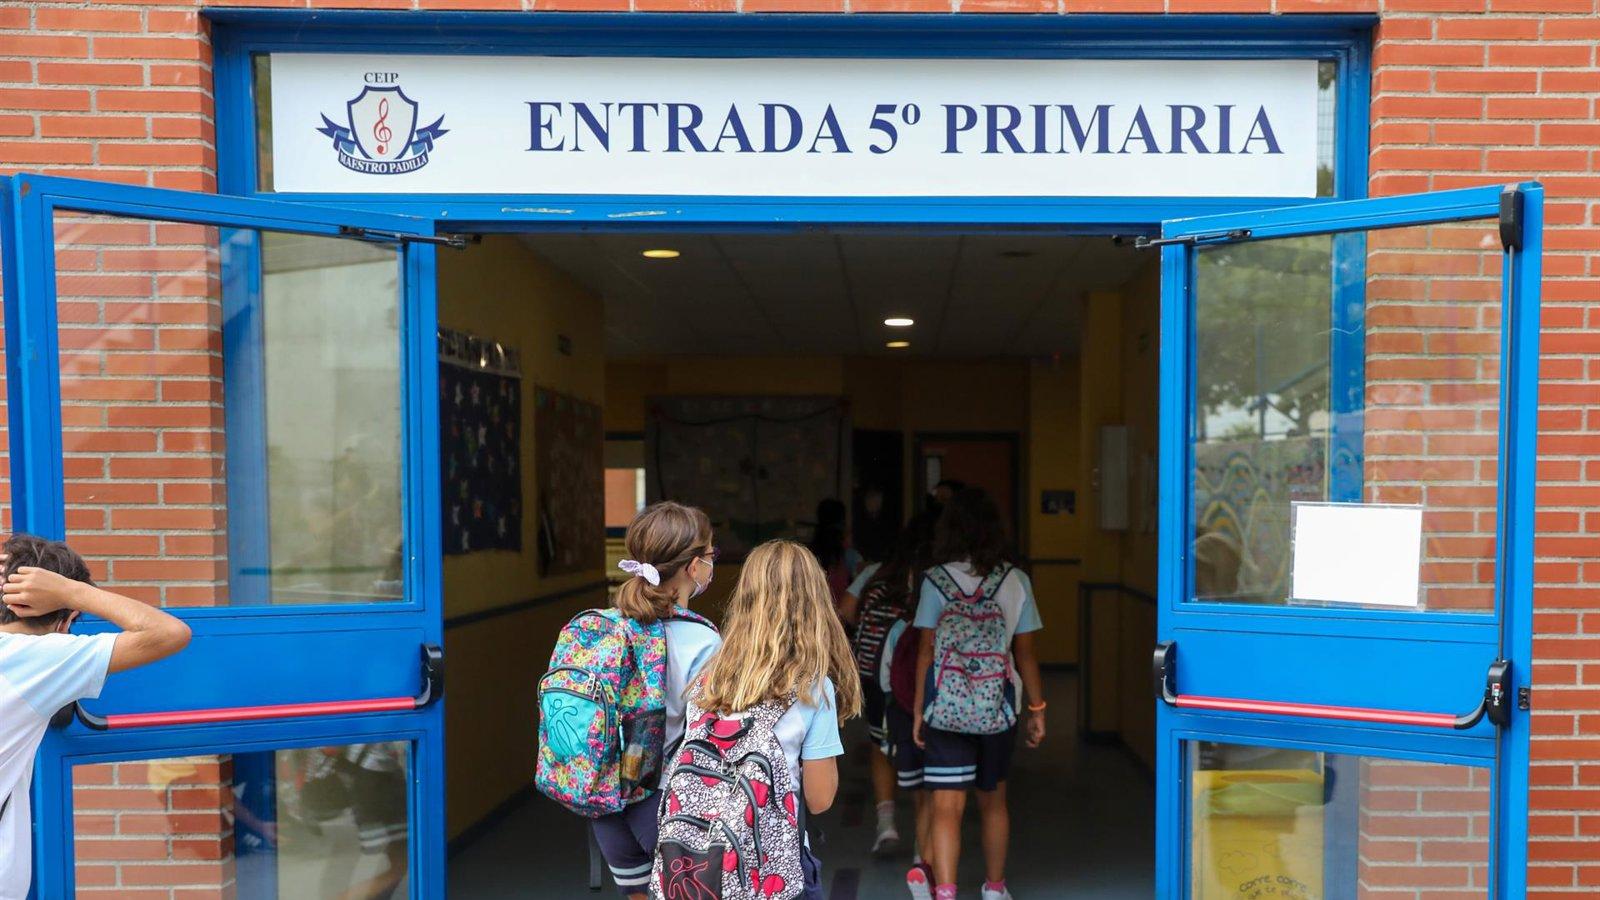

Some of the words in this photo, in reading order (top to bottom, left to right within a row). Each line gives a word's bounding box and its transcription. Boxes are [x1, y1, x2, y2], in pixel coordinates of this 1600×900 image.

[364, 72, 399, 83] CEIP
[525, 101, 853, 153] ENTRADA
[868, 103, 922, 155] 5º
[941, 104, 1284, 155] PRIMARIA
[339, 151, 388, 173] MAESTRO
[388, 155, 429, 173] PADILLA
